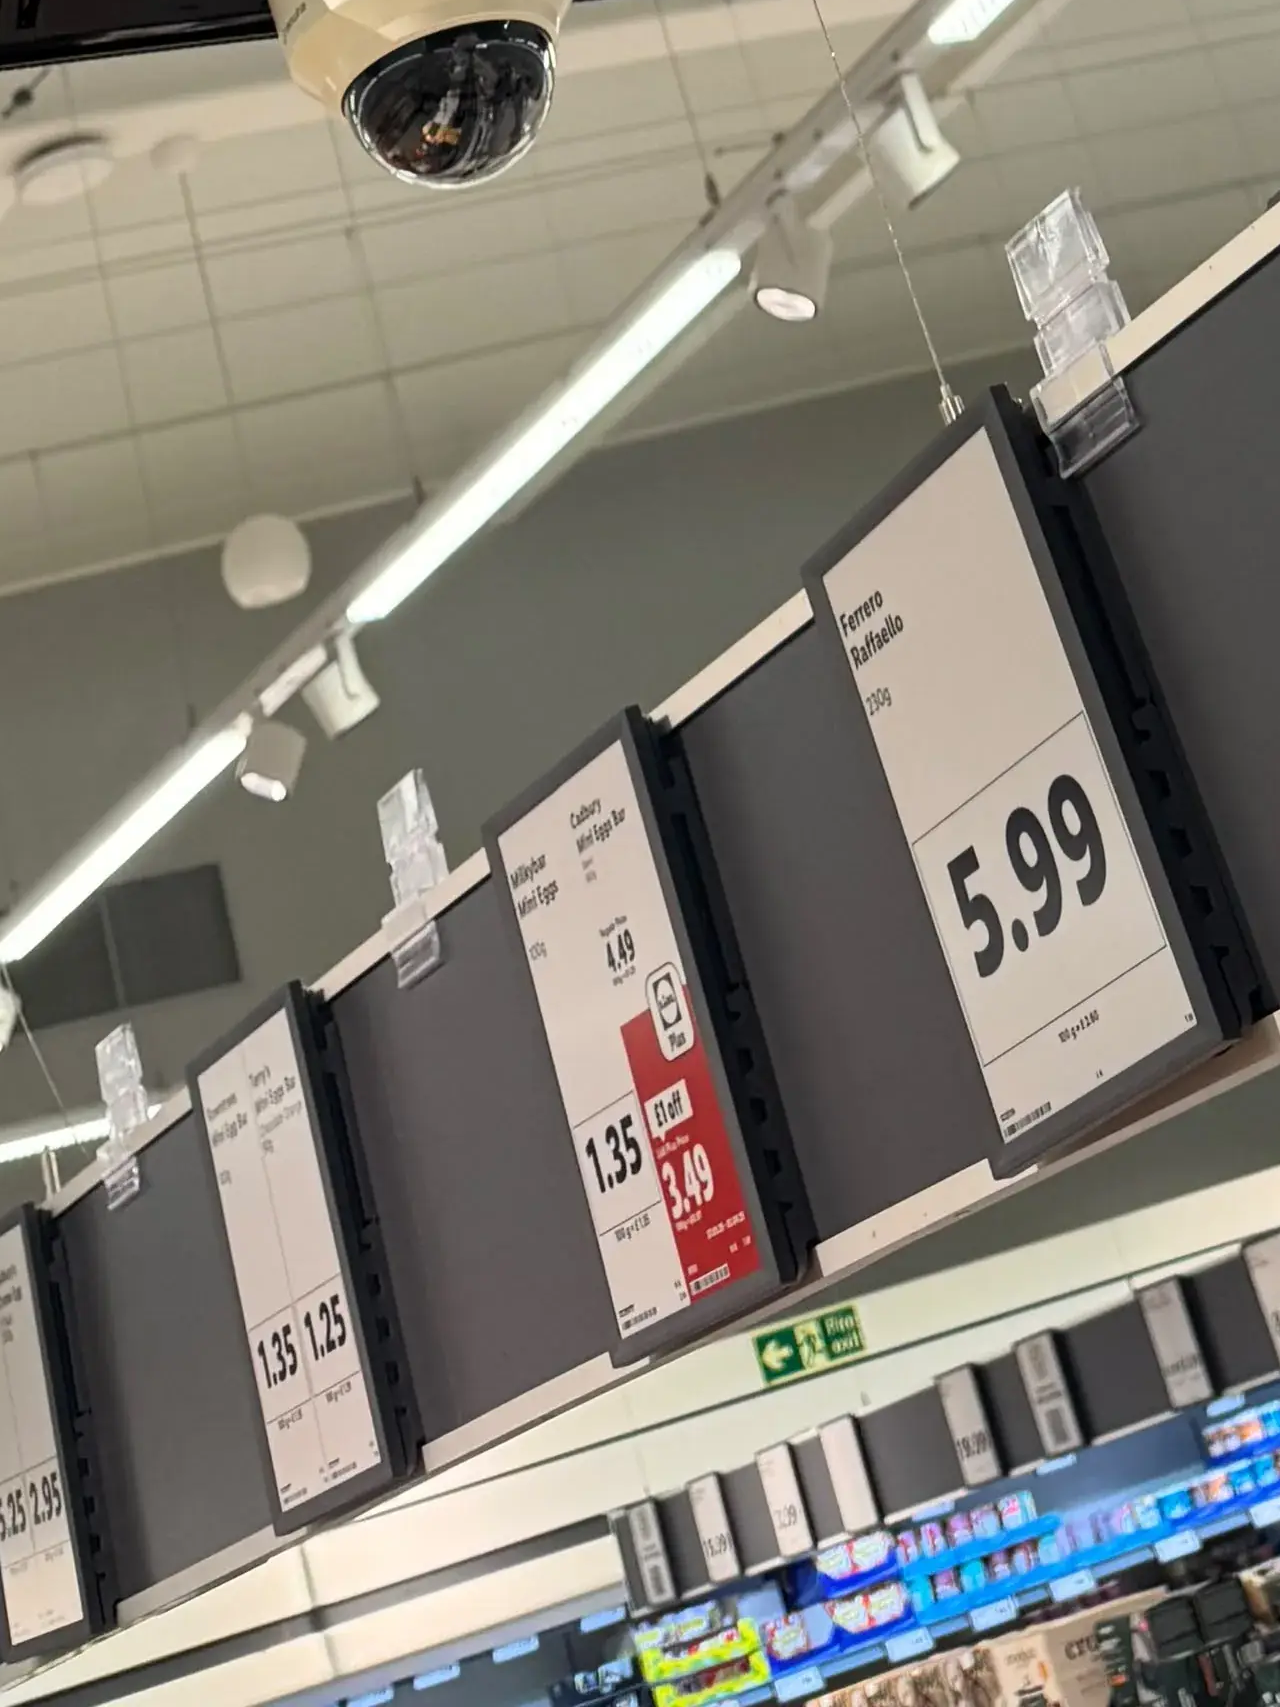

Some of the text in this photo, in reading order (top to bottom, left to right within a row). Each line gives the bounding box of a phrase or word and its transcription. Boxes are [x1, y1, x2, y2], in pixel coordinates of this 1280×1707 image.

[838, 589, 884, 639] Ferrero
[849, 612, 905, 671] Raffaello
[864, 686, 893, 717] 230g
[569, 797, 603, 831] Cadbury
[592, 818, 614, 844] Eggs
[610, 806, 627, 828] Bar
[509, 853, 548, 892] Milkybar
[944, 772, 1109, 980] 5.99
[517, 879, 561, 919] Mini Eggs
[605, 927, 637, 973] 4.49
[667, 1031, 688, 1053] Plus
[652, 1089, 685, 1129] £1 off
[584, 1114, 643, 1194] 1.35
[660, 1142, 716, 1220] 3.49
[303, 1293, 348, 1362] 1.25
[256, 1322, 299, 1390] 1.35
[28, 1470, 63, 1526] 2.95
